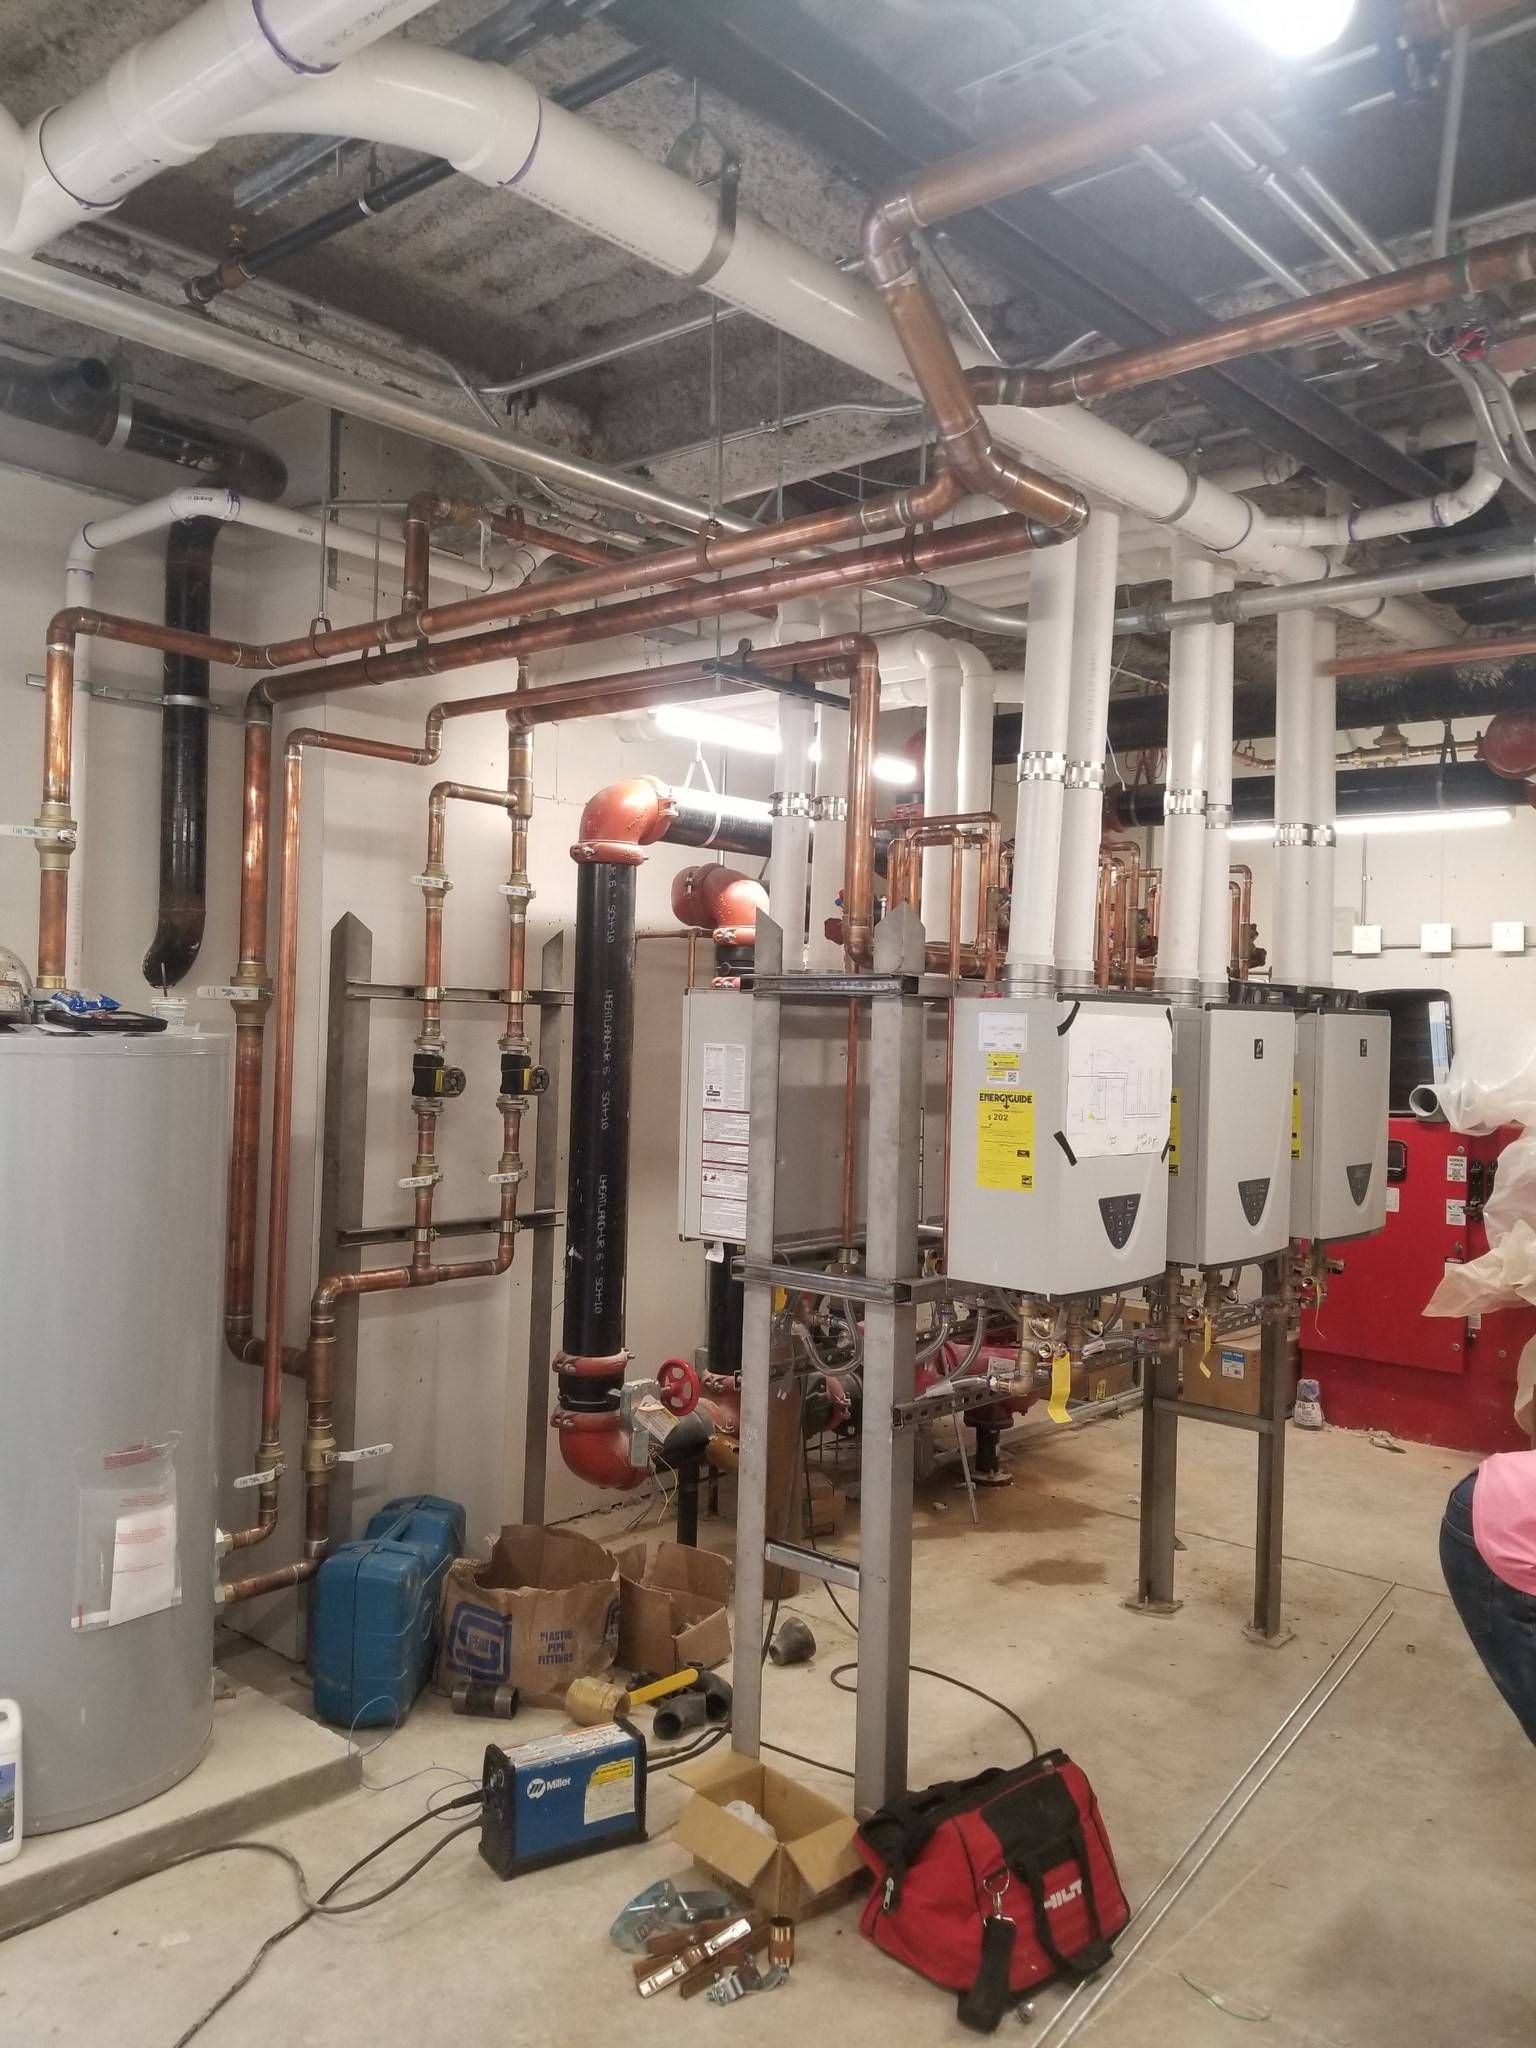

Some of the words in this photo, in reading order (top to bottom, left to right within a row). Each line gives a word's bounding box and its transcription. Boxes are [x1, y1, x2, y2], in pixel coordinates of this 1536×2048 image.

[979, 1093, 1032, 1104] ENERGYGUIDE
[546, 1777, 571, 1792] Miller
[1043, 1879, 1082, 1909] HILT
